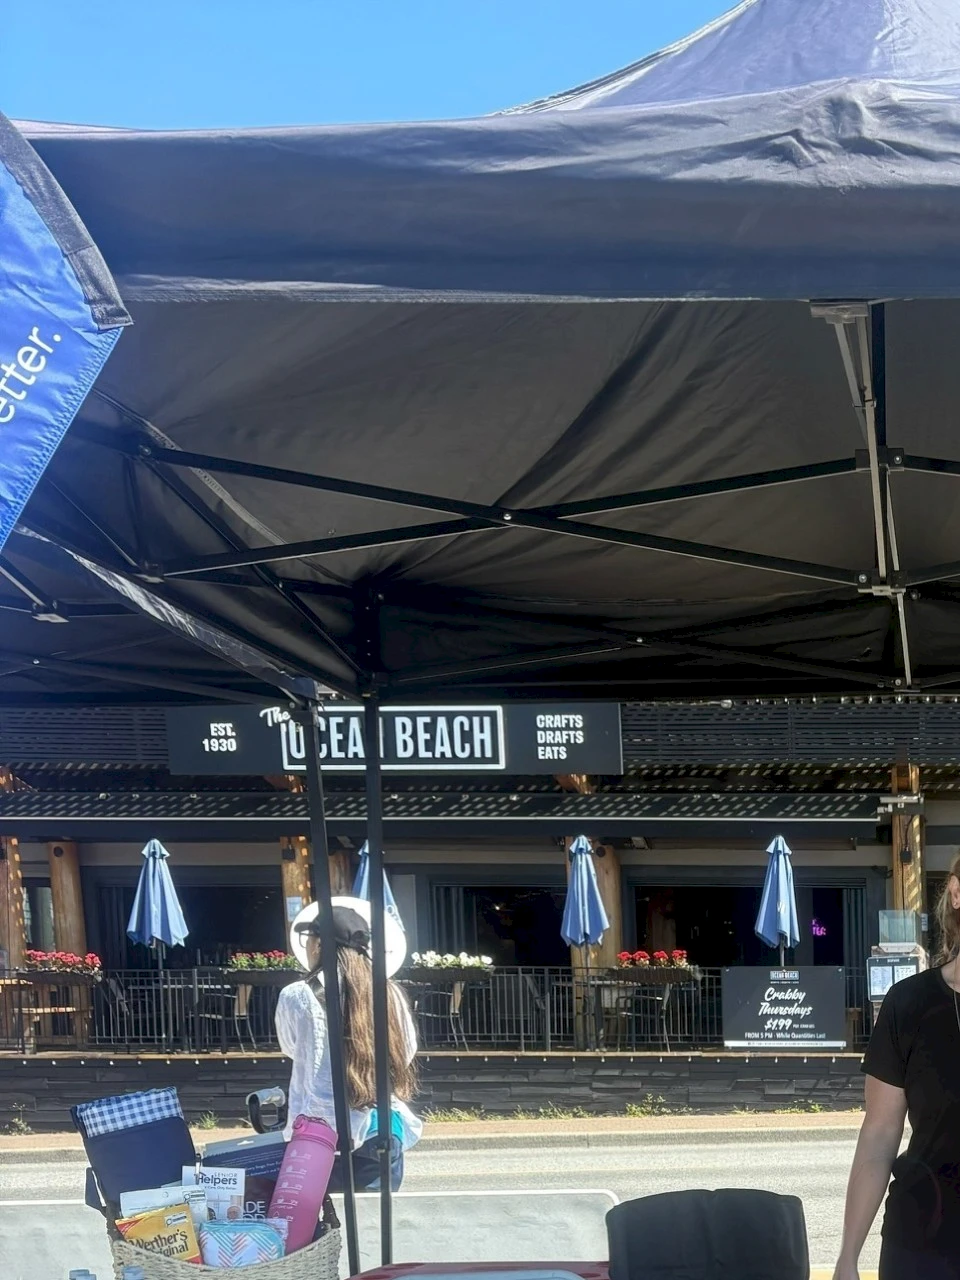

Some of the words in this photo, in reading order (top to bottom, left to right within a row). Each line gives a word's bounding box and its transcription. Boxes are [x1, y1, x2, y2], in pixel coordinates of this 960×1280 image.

[259, 706, 291, 727] The
[536, 714, 583, 728] CRAFTS
[210, 723, 236, 736] EST.
[395, 715, 493, 759] BEACH
[537, 730, 584, 744] DRAFTS
[202, 738, 237, 752] 1930
[538, 746, 567, 760] EATS
[764, 987, 806, 1004] Crabby
[758, 1002, 813, 1019] Thursdays
[129, 1228, 188, 1251] Werther's
